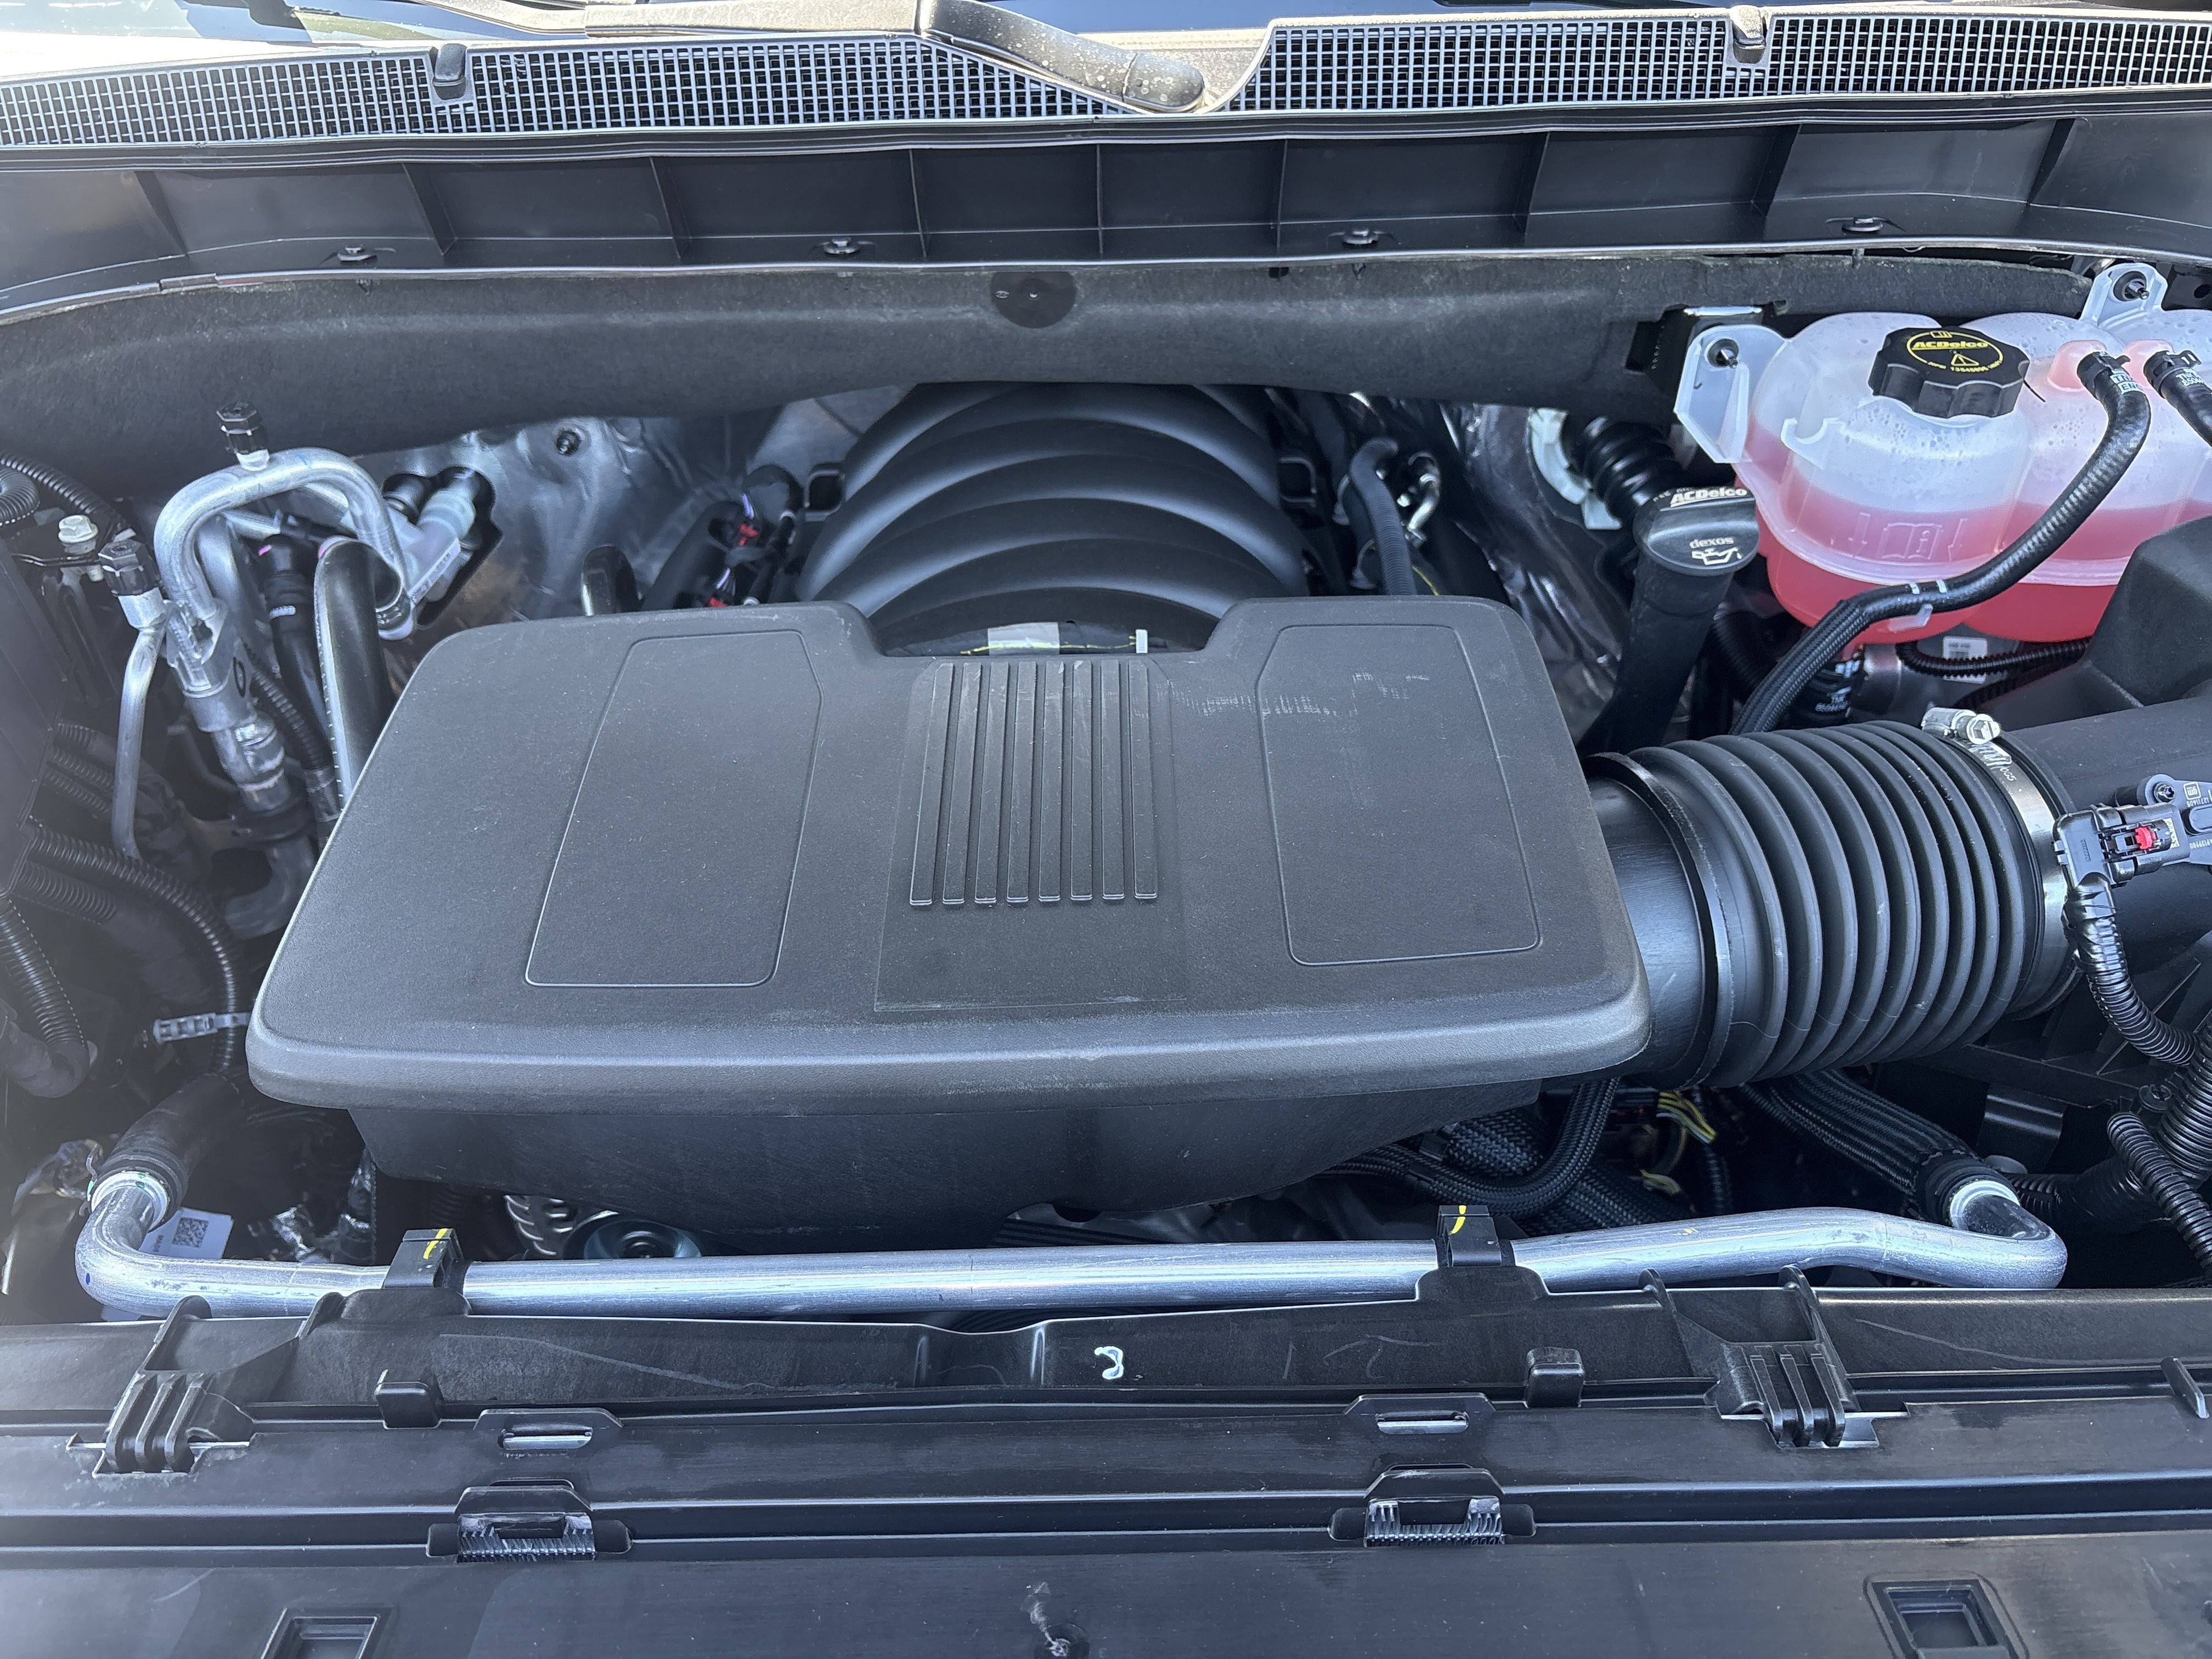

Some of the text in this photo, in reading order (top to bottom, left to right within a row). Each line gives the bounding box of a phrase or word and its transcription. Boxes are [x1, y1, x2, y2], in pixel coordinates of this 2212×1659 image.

[1912, 341, 1989, 349] ACDelco
[1670, 487, 1747, 505] ACDelco
[1689, 537, 1735, 549] dexos
